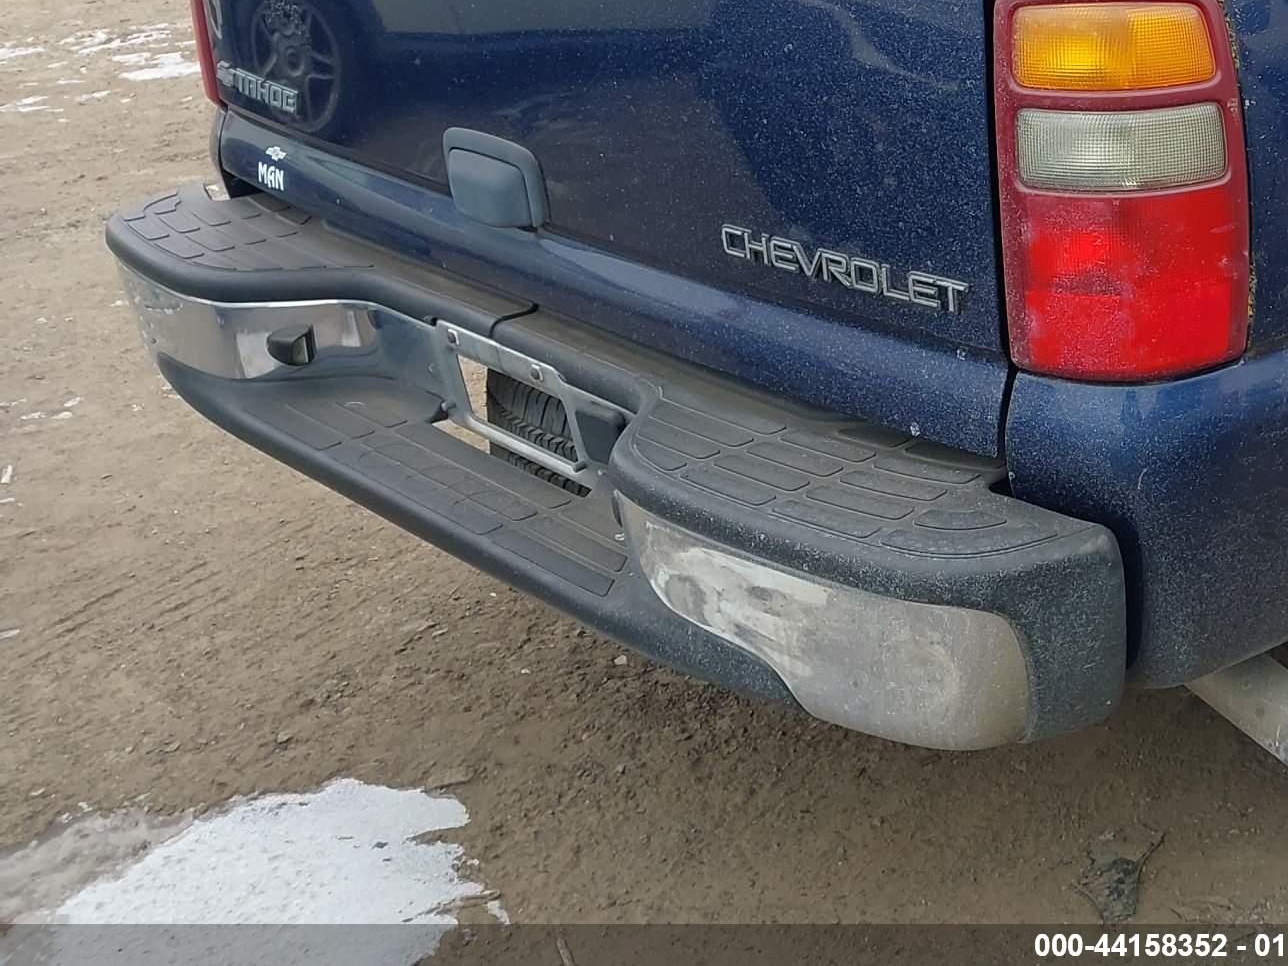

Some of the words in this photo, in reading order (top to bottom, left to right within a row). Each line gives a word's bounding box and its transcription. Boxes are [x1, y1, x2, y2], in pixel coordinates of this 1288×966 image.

[233, 68, 299, 114] TAHOE
[258, 161, 284, 191] MAN
[721, 223, 968, 313] CHEVROLET
